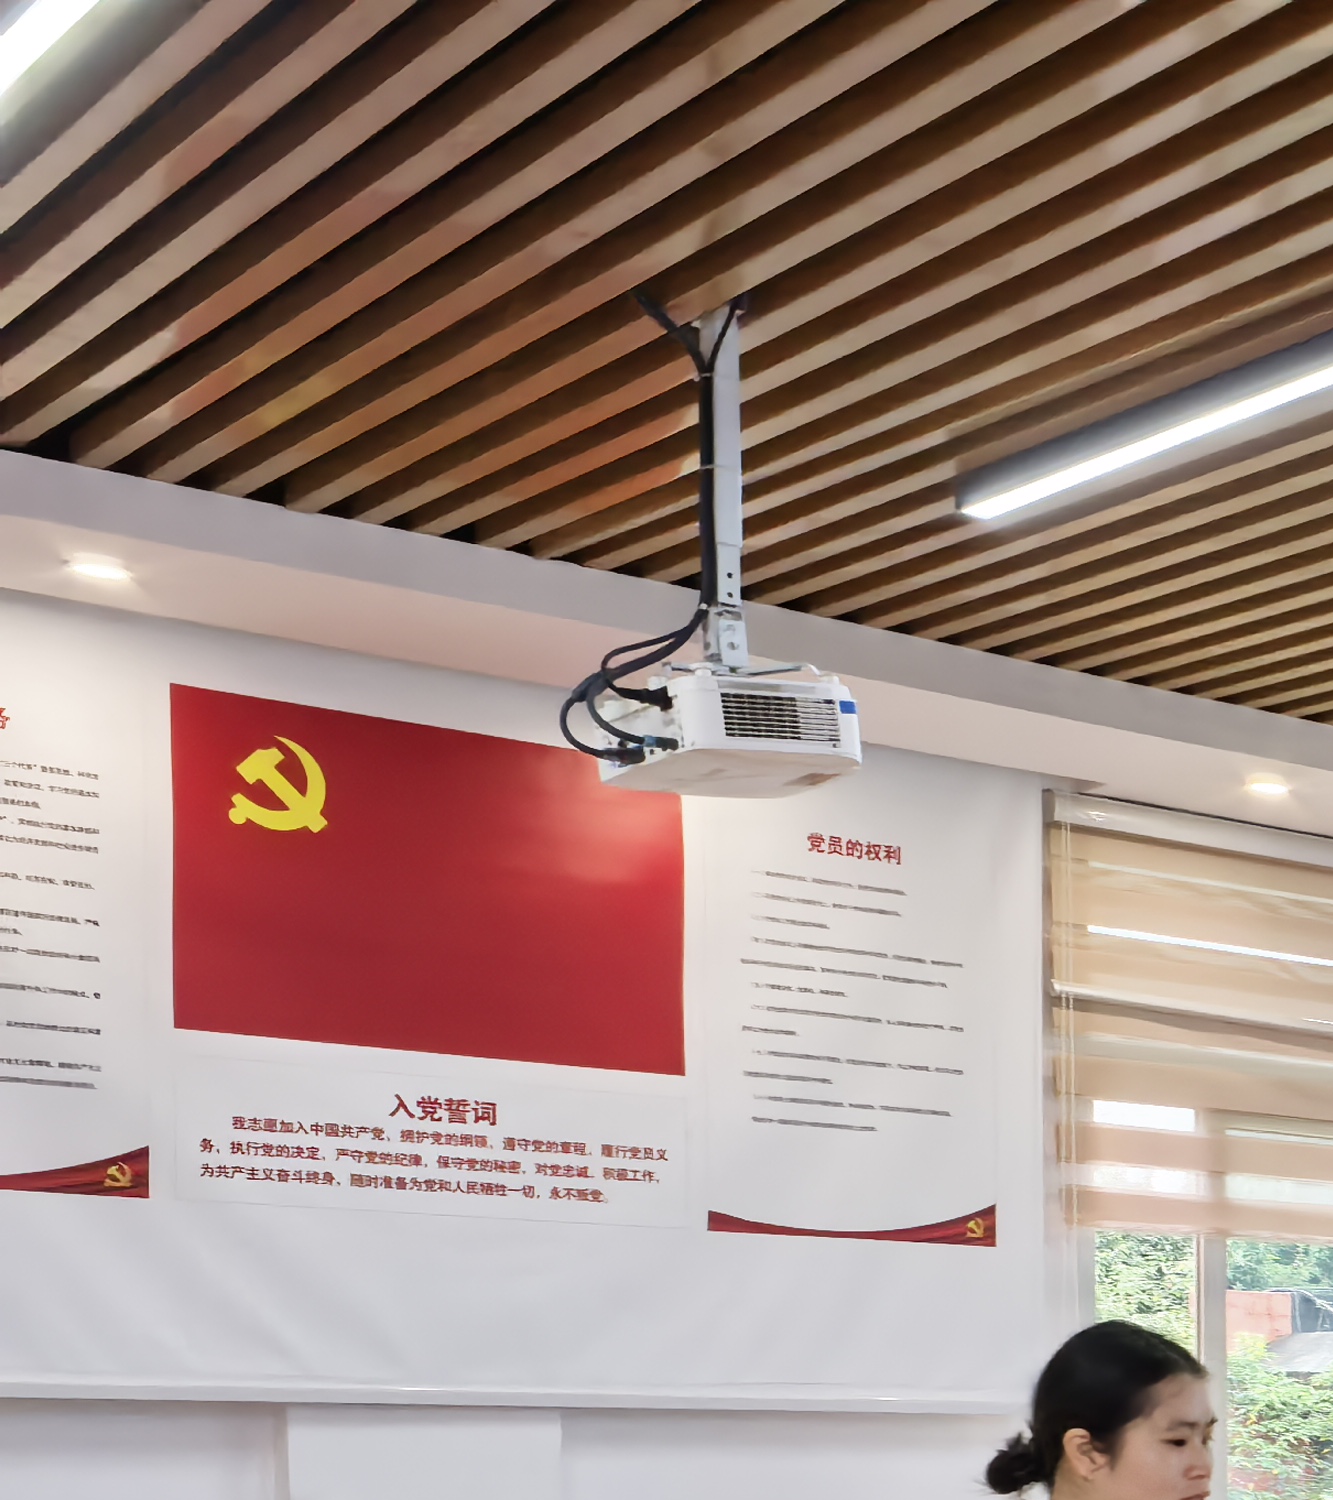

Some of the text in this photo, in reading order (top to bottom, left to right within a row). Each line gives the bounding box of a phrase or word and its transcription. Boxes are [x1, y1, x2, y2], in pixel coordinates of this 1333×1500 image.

[807, 832, 902, 865] 党员的权利
[389, 1094, 497, 1126] 入党誓词
